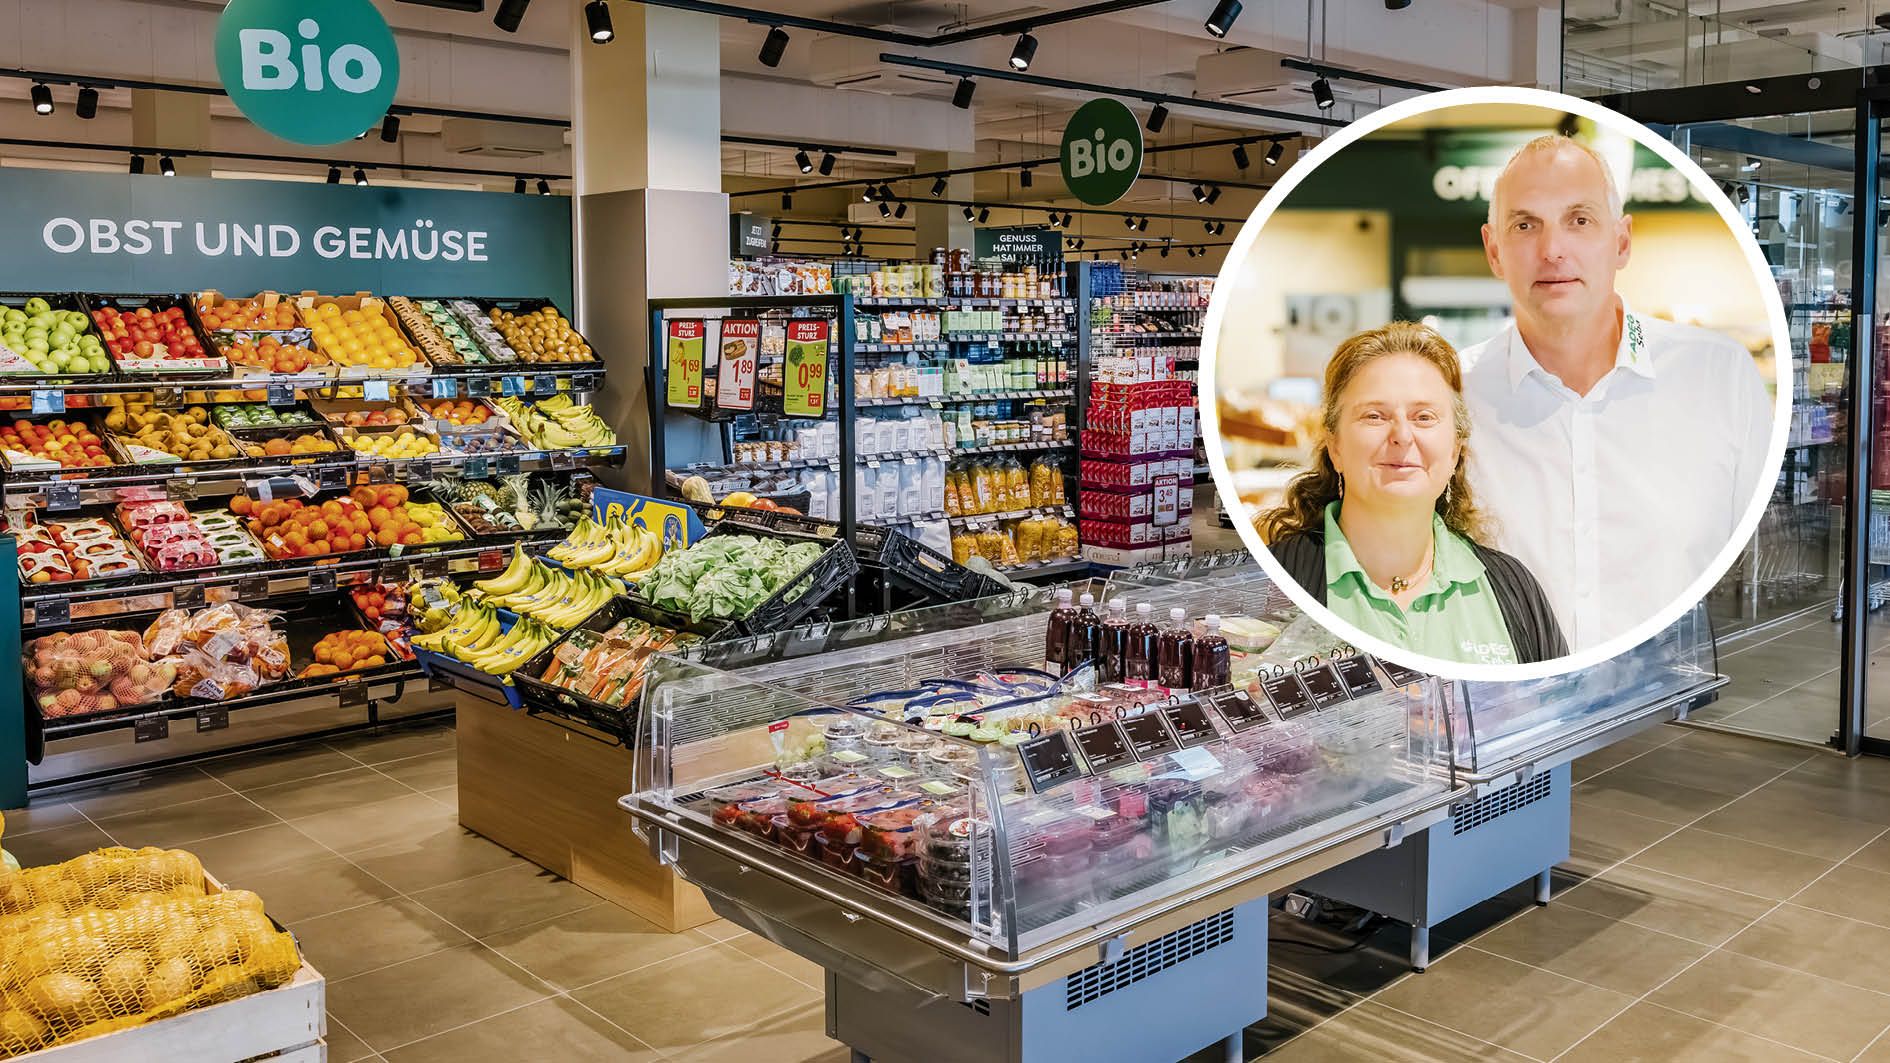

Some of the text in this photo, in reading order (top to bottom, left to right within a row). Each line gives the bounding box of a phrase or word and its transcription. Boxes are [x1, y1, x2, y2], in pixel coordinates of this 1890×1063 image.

[239, 18, 382, 93] Bio
[1069, 127, 1134, 178] Bio
[42, 216, 488, 261] OBST UND GEMÜSE
[999, 234, 1037, 243] GENUSS
[993, 244, 1043, 252] HAT IMMER
[723, 322, 758, 335] AKTION
[797, 323, 821, 331] PREIS-
[796, 331, 818, 340] STURZ
